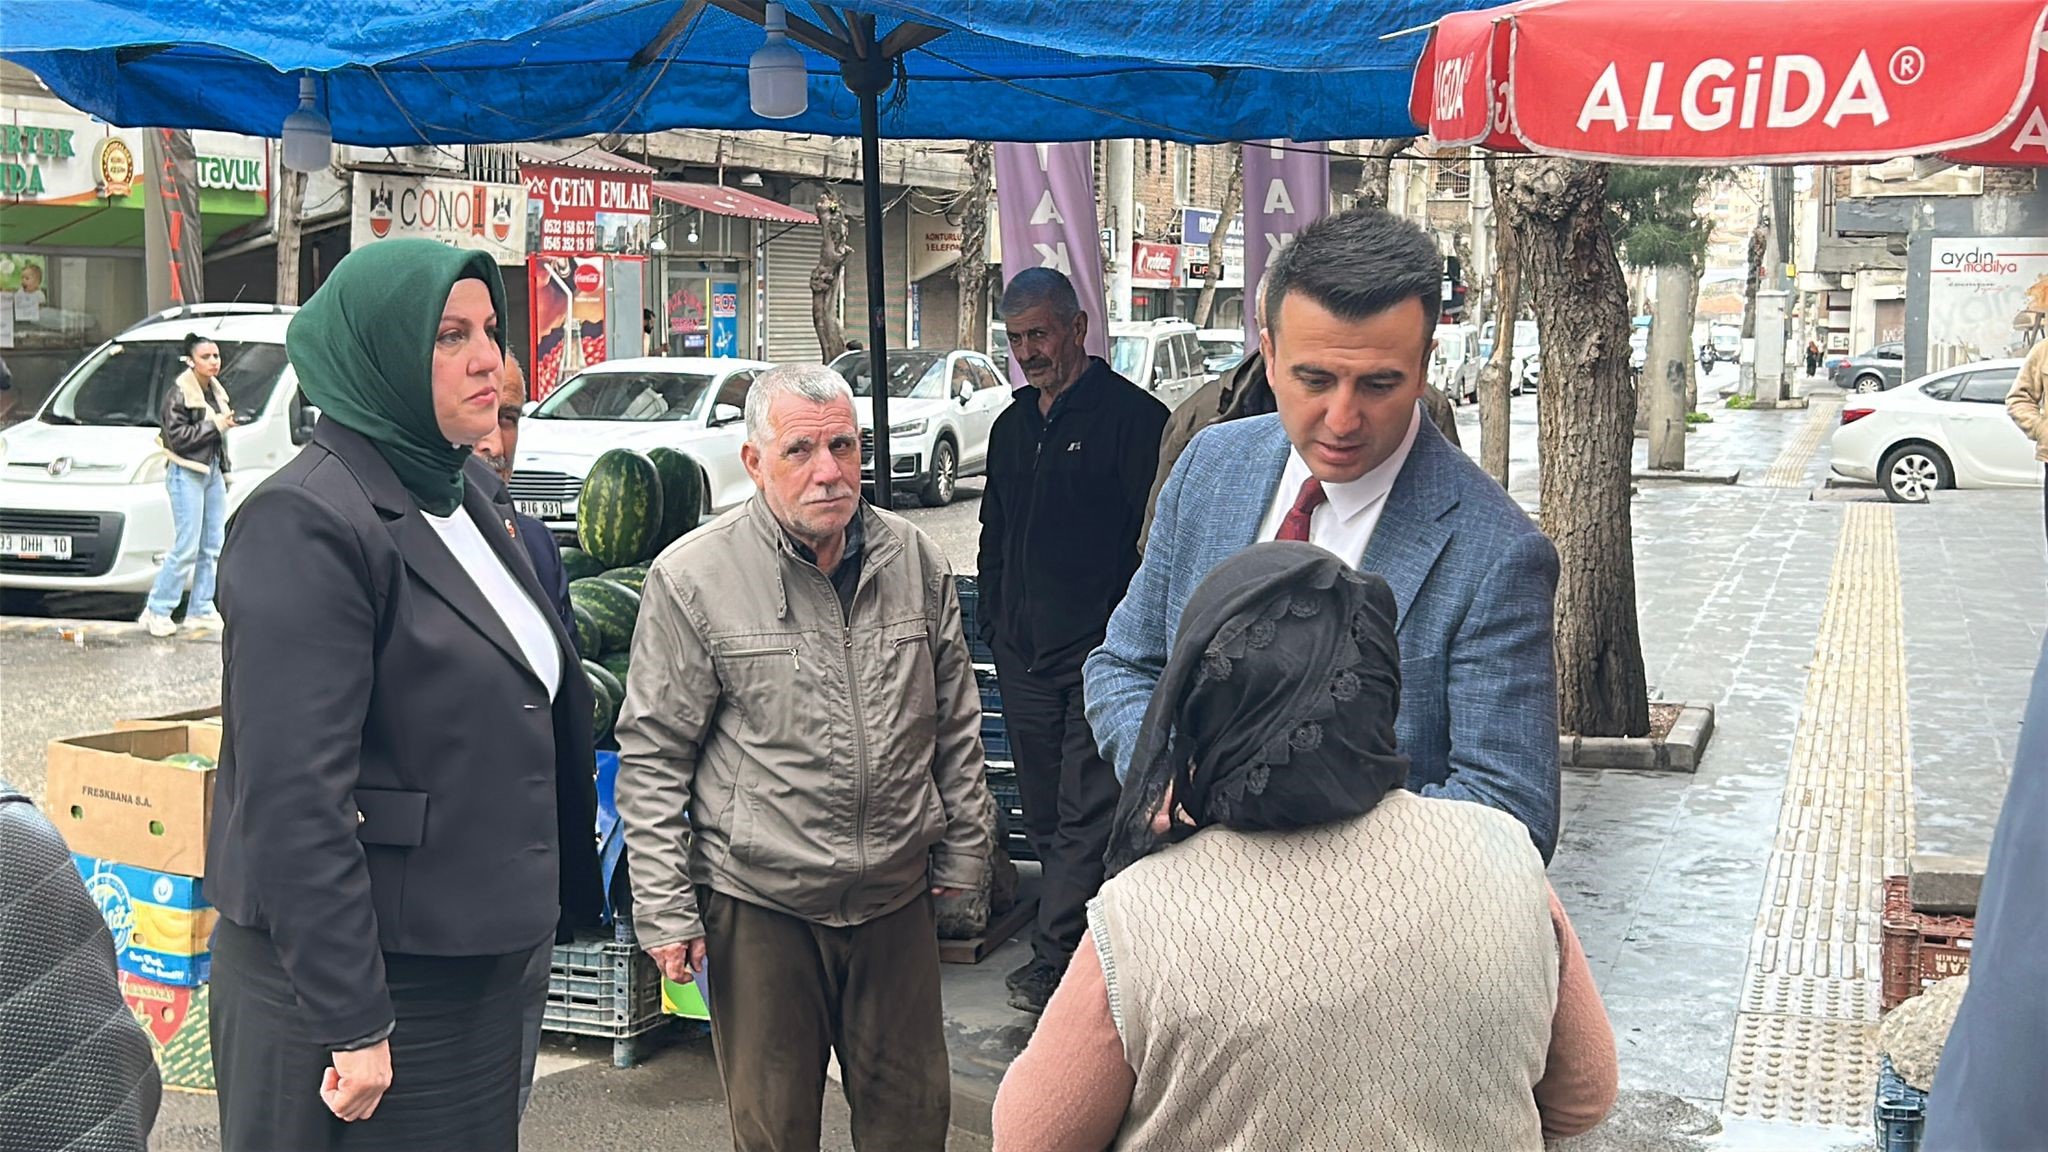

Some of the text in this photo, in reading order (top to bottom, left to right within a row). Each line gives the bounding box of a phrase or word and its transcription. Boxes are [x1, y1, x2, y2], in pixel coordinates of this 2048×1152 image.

[0, 125, 76, 157] RTEK
[600, 180, 650, 210] EMLAK
[543, 219, 561, 234] 0532
[586, 220, 595, 234] 72
[562, 236, 575, 251] 352
[1941, 247, 1993, 268] aydın
[1964, 260, 2017, 275] mobilya
[543, 502, 559, 514] 931
[21, 535, 42, 552] DHH
[54, 537, 67, 552] 10
[82, 785, 152, 808] FRESKBANA S.A.
